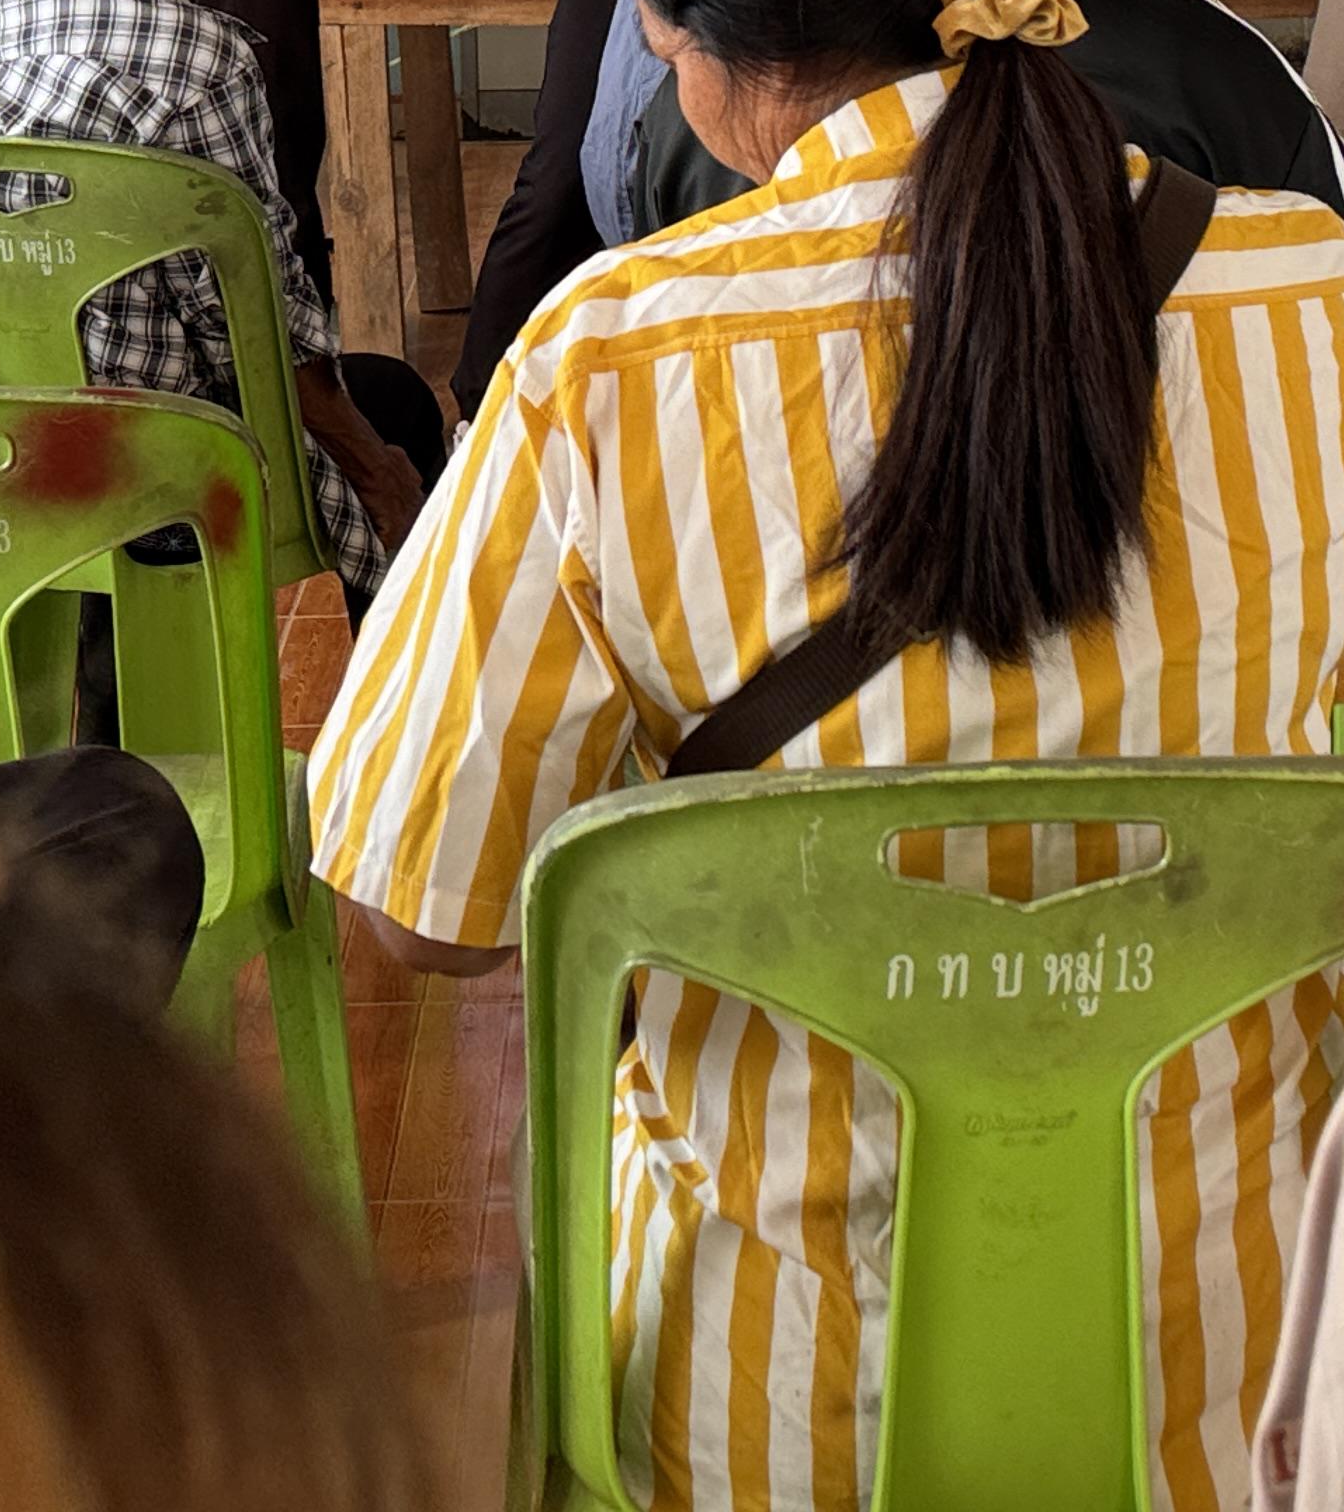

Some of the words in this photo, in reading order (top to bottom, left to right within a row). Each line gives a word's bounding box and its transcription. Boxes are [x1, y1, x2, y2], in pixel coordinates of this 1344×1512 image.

[56, 238, 76, 264] 13
[886, 953, 915, 1001] ก
[937, 952, 970, 1000] ท
[991, 951, 1024, 999] บ
[1043, 933, 1106, 1017] หมู่
[1114, 942, 1155, 993] 13
